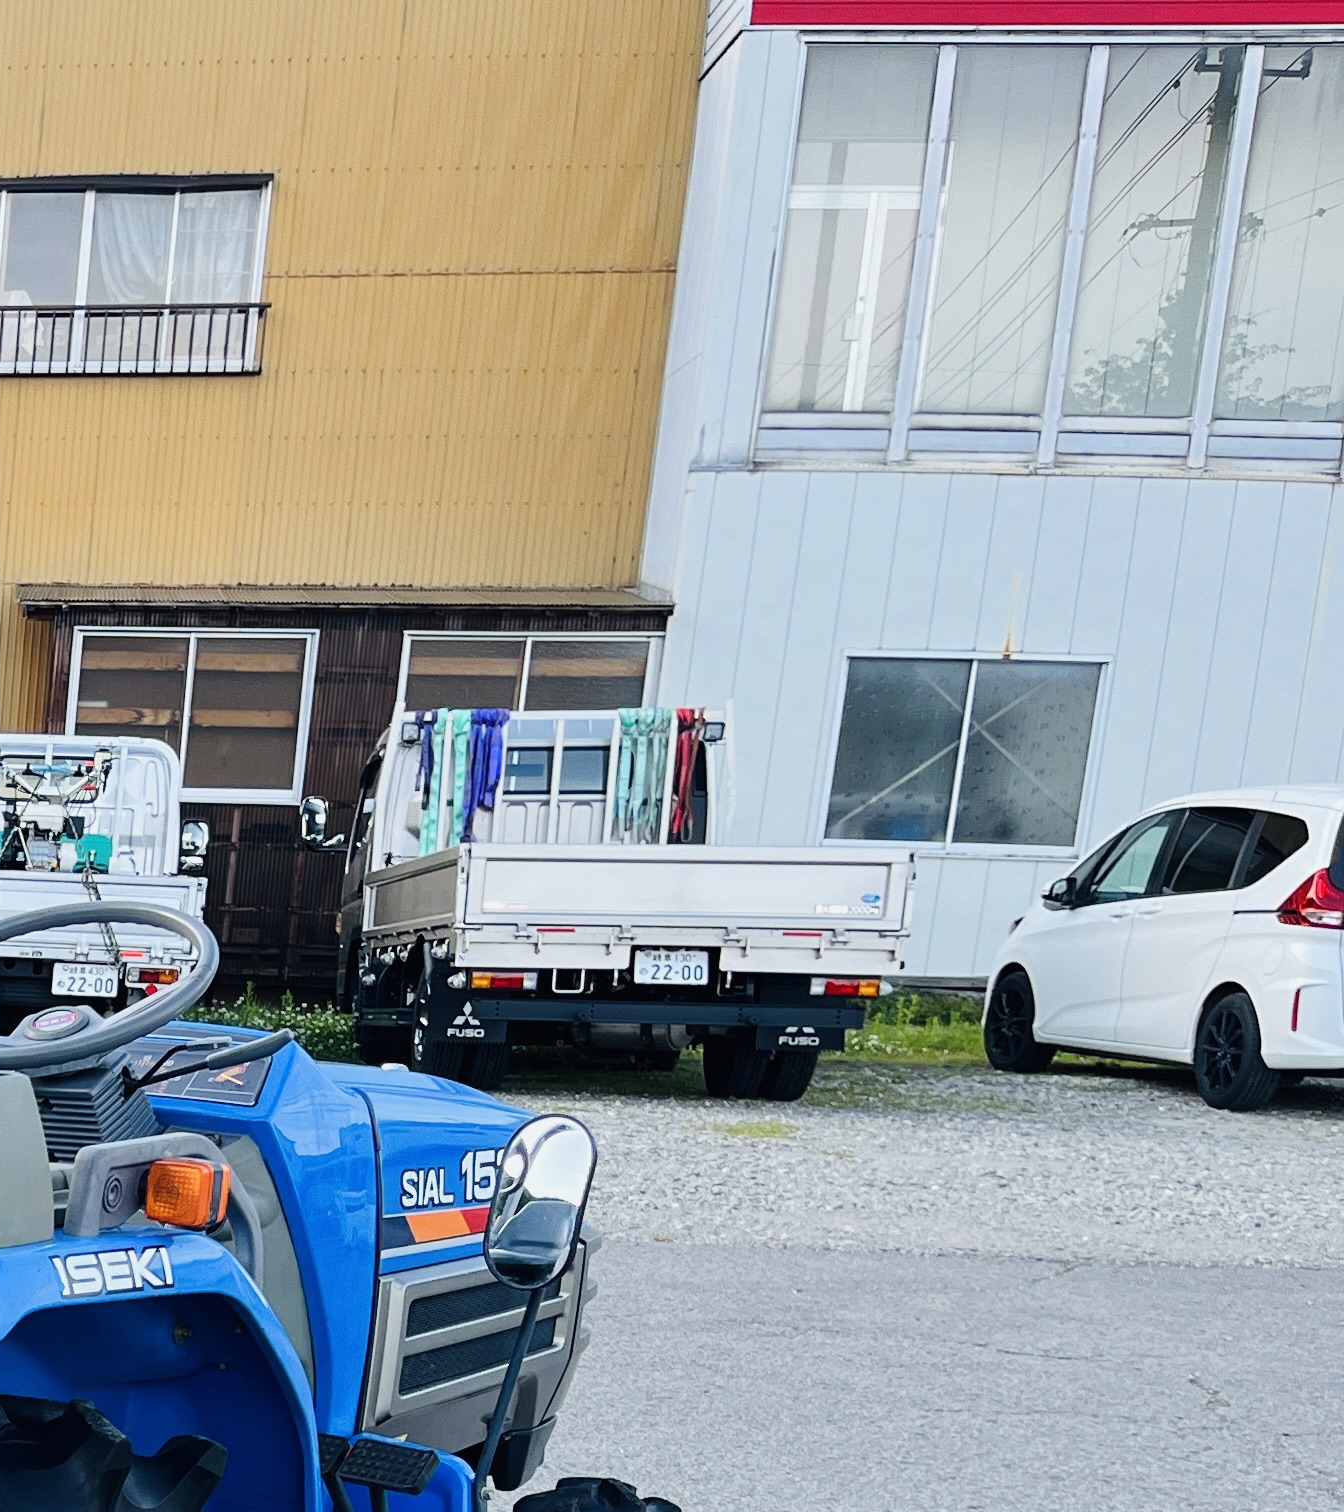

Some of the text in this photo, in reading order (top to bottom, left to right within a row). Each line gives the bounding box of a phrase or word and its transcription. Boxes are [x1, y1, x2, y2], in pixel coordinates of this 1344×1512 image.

[88, 967, 104, 975] 430
[651, 964, 703, 980] 22-00
[67, 976, 113, 993] 22-00
[446, 1027, 485, 1038] FUSO
[778, 1035, 820, 1046] FUSO
[400, 1167, 455, 1208] SIAL
[50, 1245, 174, 1297] ISEKI
